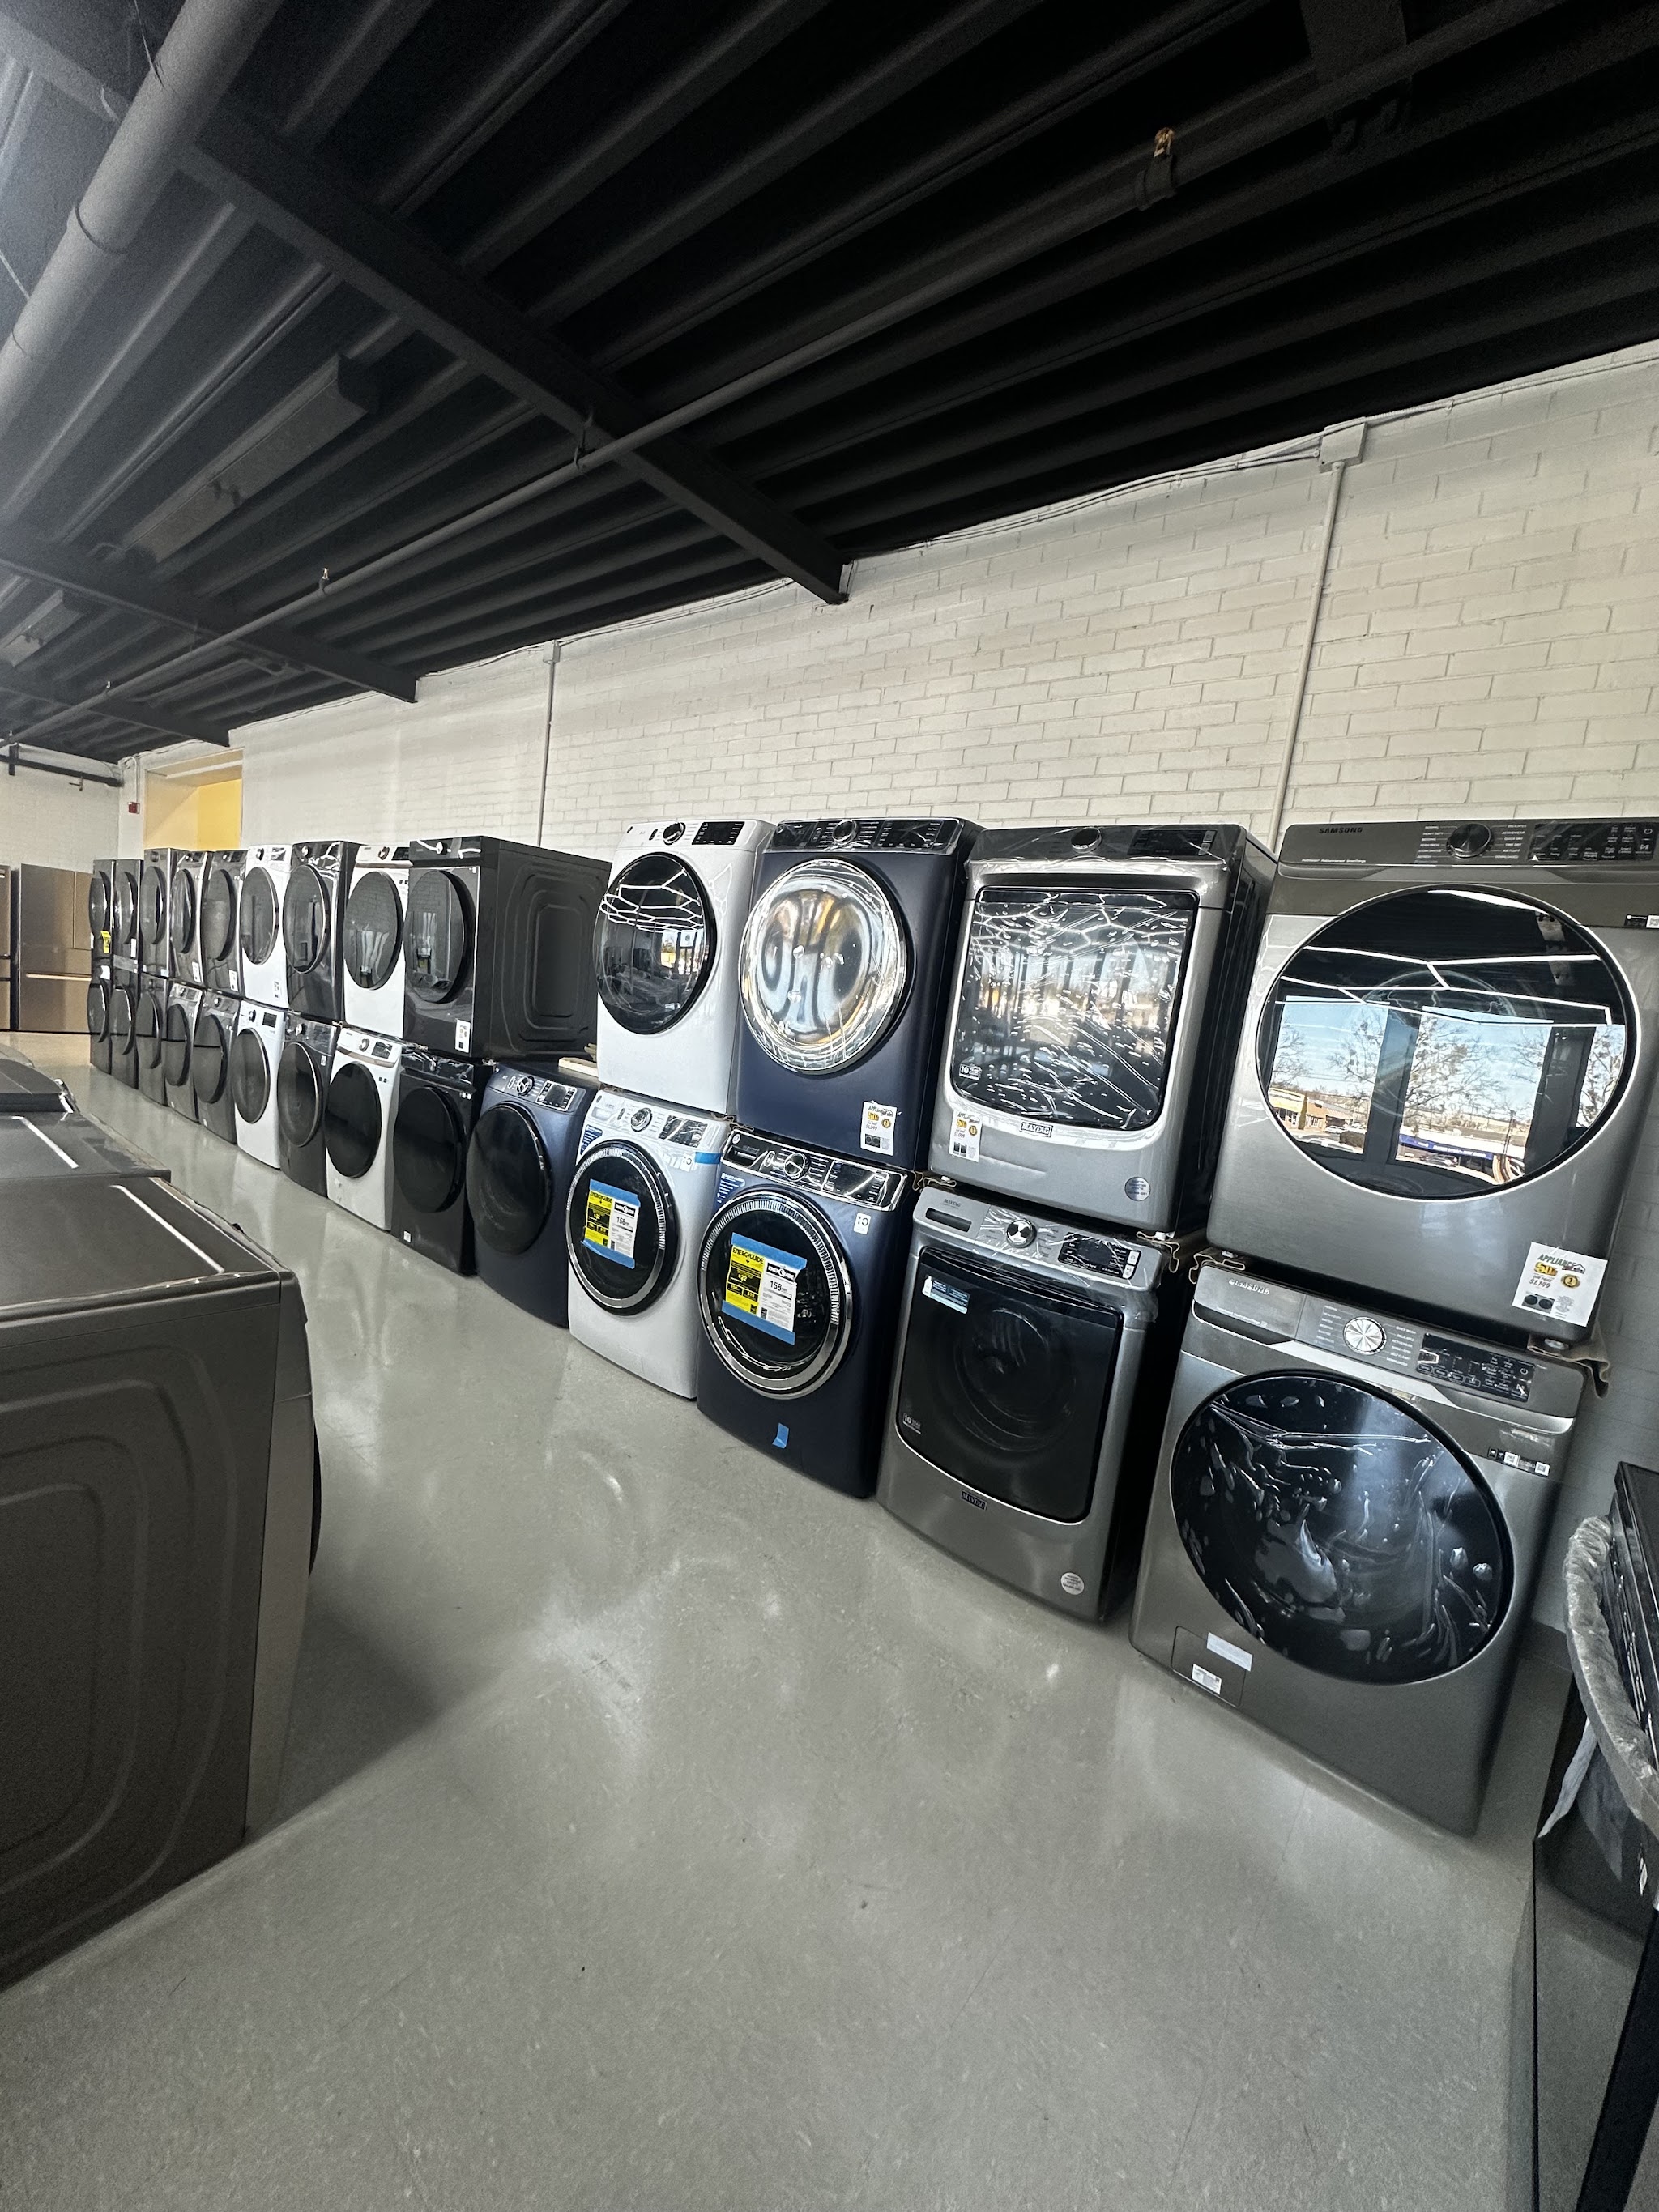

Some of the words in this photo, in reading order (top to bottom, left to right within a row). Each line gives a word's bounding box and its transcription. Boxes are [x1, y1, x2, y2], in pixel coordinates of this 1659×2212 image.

[1022, 1123, 1050, 1135] MAYTAG
[616, 1217, 626, 1225] 158
[732, 1247, 764, 1264] ENERGYGUIDE
[1537, 1253, 1576, 1266] APPLIANCE
[770, 1280, 783, 1292] 158
